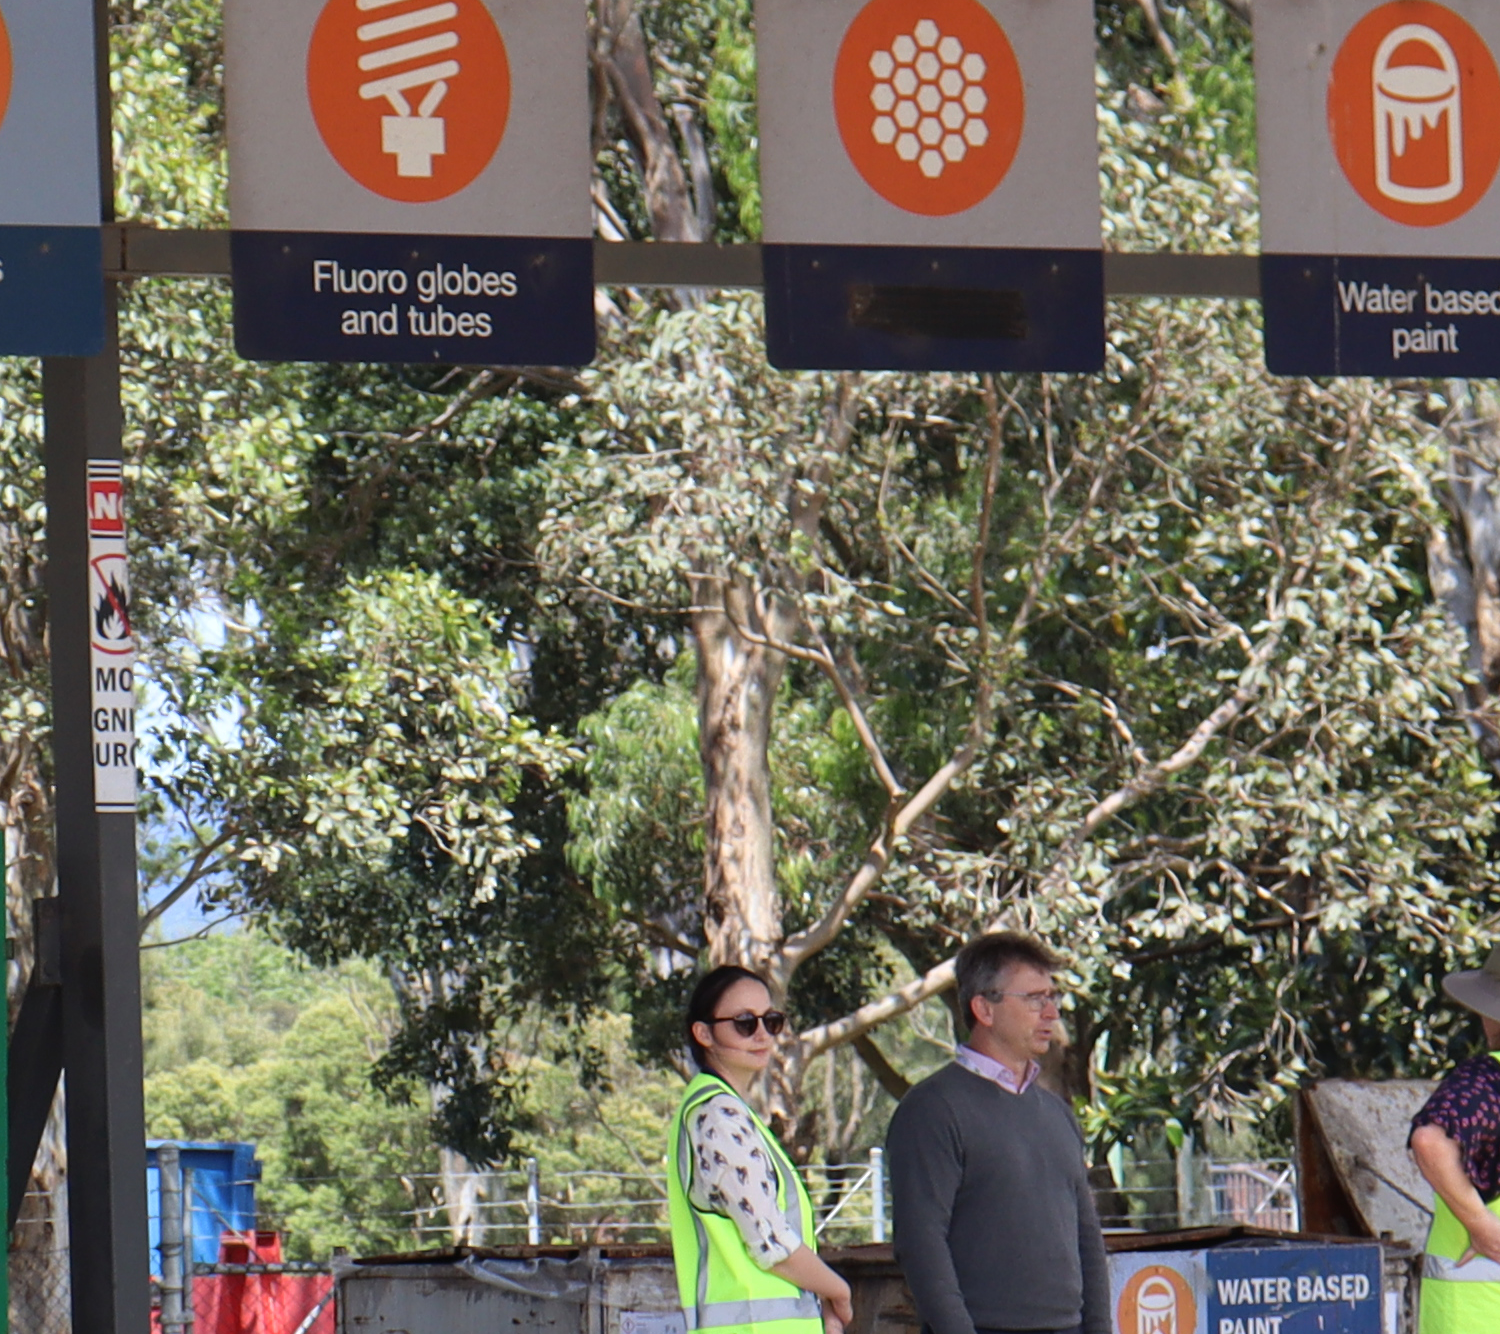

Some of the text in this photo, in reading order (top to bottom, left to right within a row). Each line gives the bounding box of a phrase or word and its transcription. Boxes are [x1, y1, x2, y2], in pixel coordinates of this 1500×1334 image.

[313, 260, 518, 303] Fluoro globes
[1338, 281, 1418, 313] Water
[341, 303, 492, 337] and tubes
[1392, 322, 1459, 359] paint
[1217, 1274, 1370, 1305] WATER BASED
